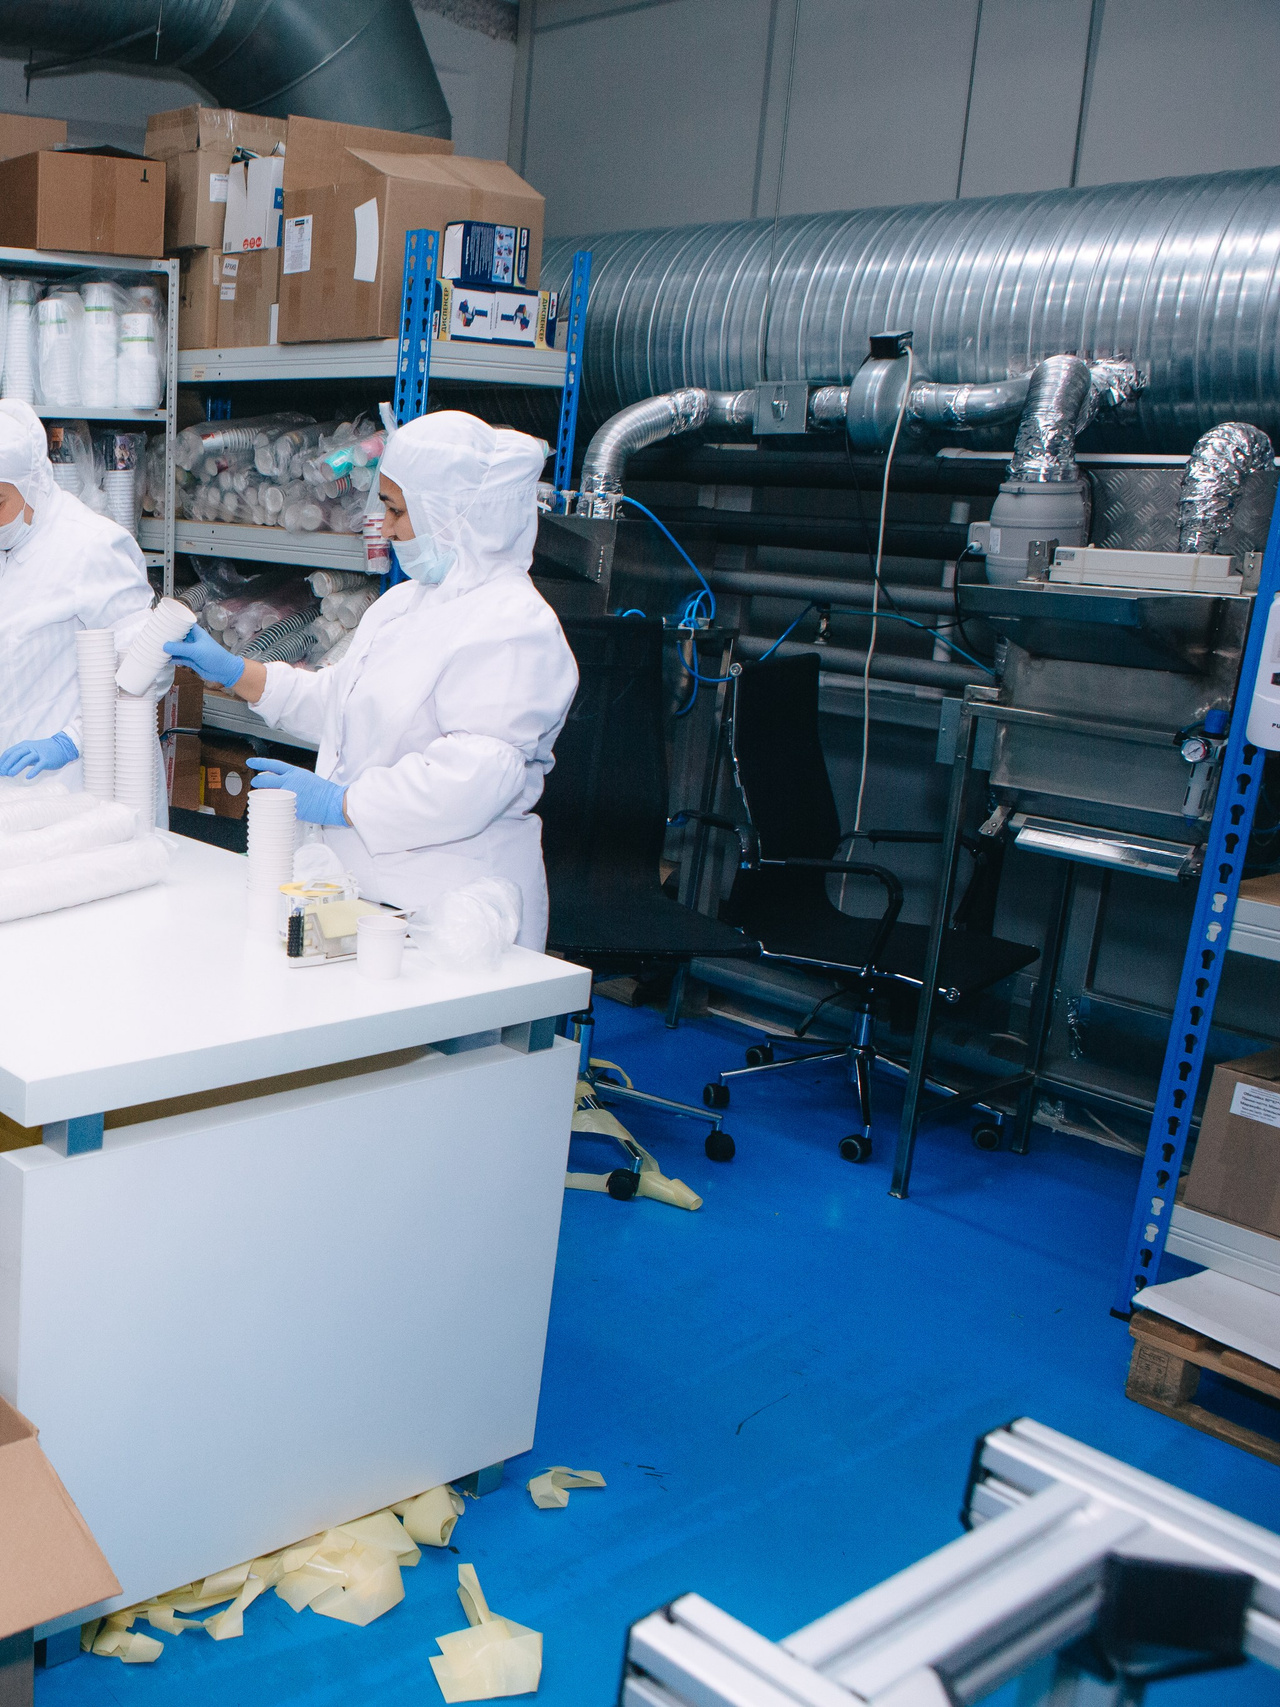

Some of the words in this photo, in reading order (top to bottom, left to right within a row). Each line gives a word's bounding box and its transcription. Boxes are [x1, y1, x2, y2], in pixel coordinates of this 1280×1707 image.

[225, 262, 237, 271] АРХИВ
[441, 287, 450, 333] ДИСПЕНСЕР
[539, 298, 549, 342] ДИСПЕНСЕР
